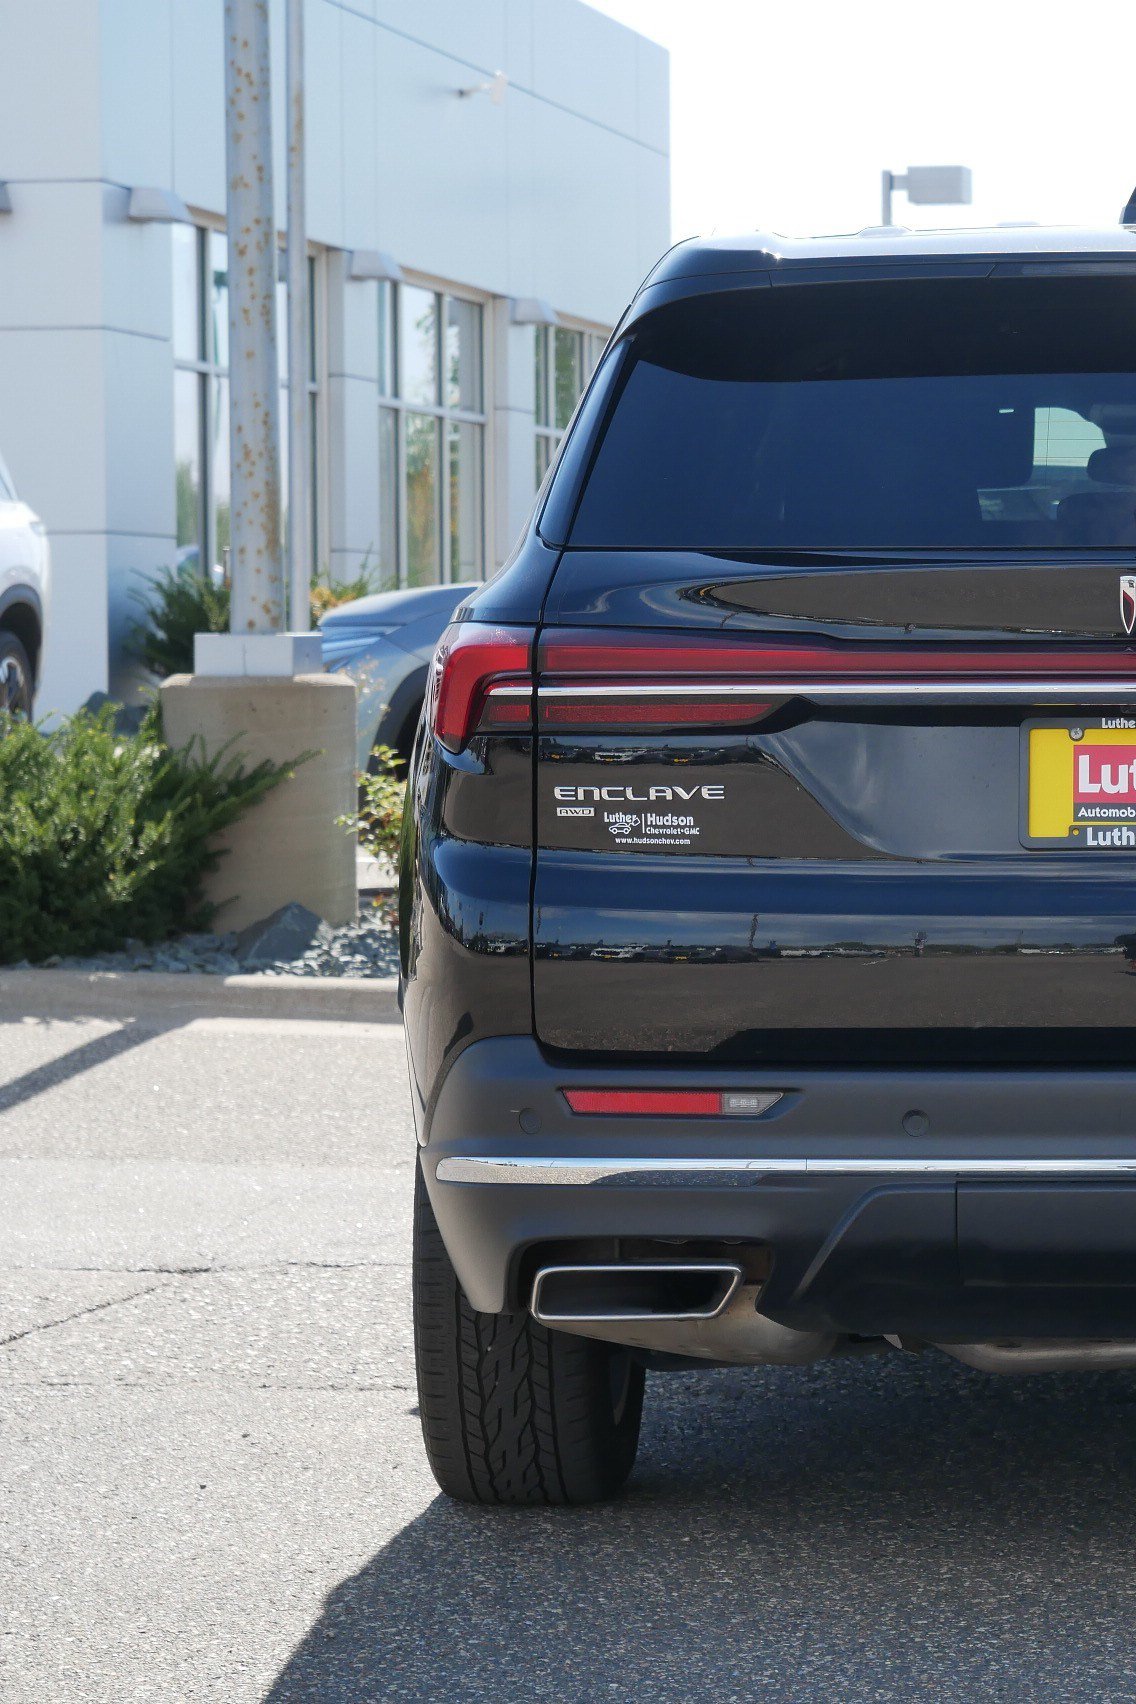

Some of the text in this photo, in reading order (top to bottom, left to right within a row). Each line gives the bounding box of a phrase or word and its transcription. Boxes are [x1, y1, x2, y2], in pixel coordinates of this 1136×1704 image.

[553, 785, 725, 801] ENCLAVE
[558, 808, 593, 816] AWD
[603, 811, 694, 826] Luther Hudson
